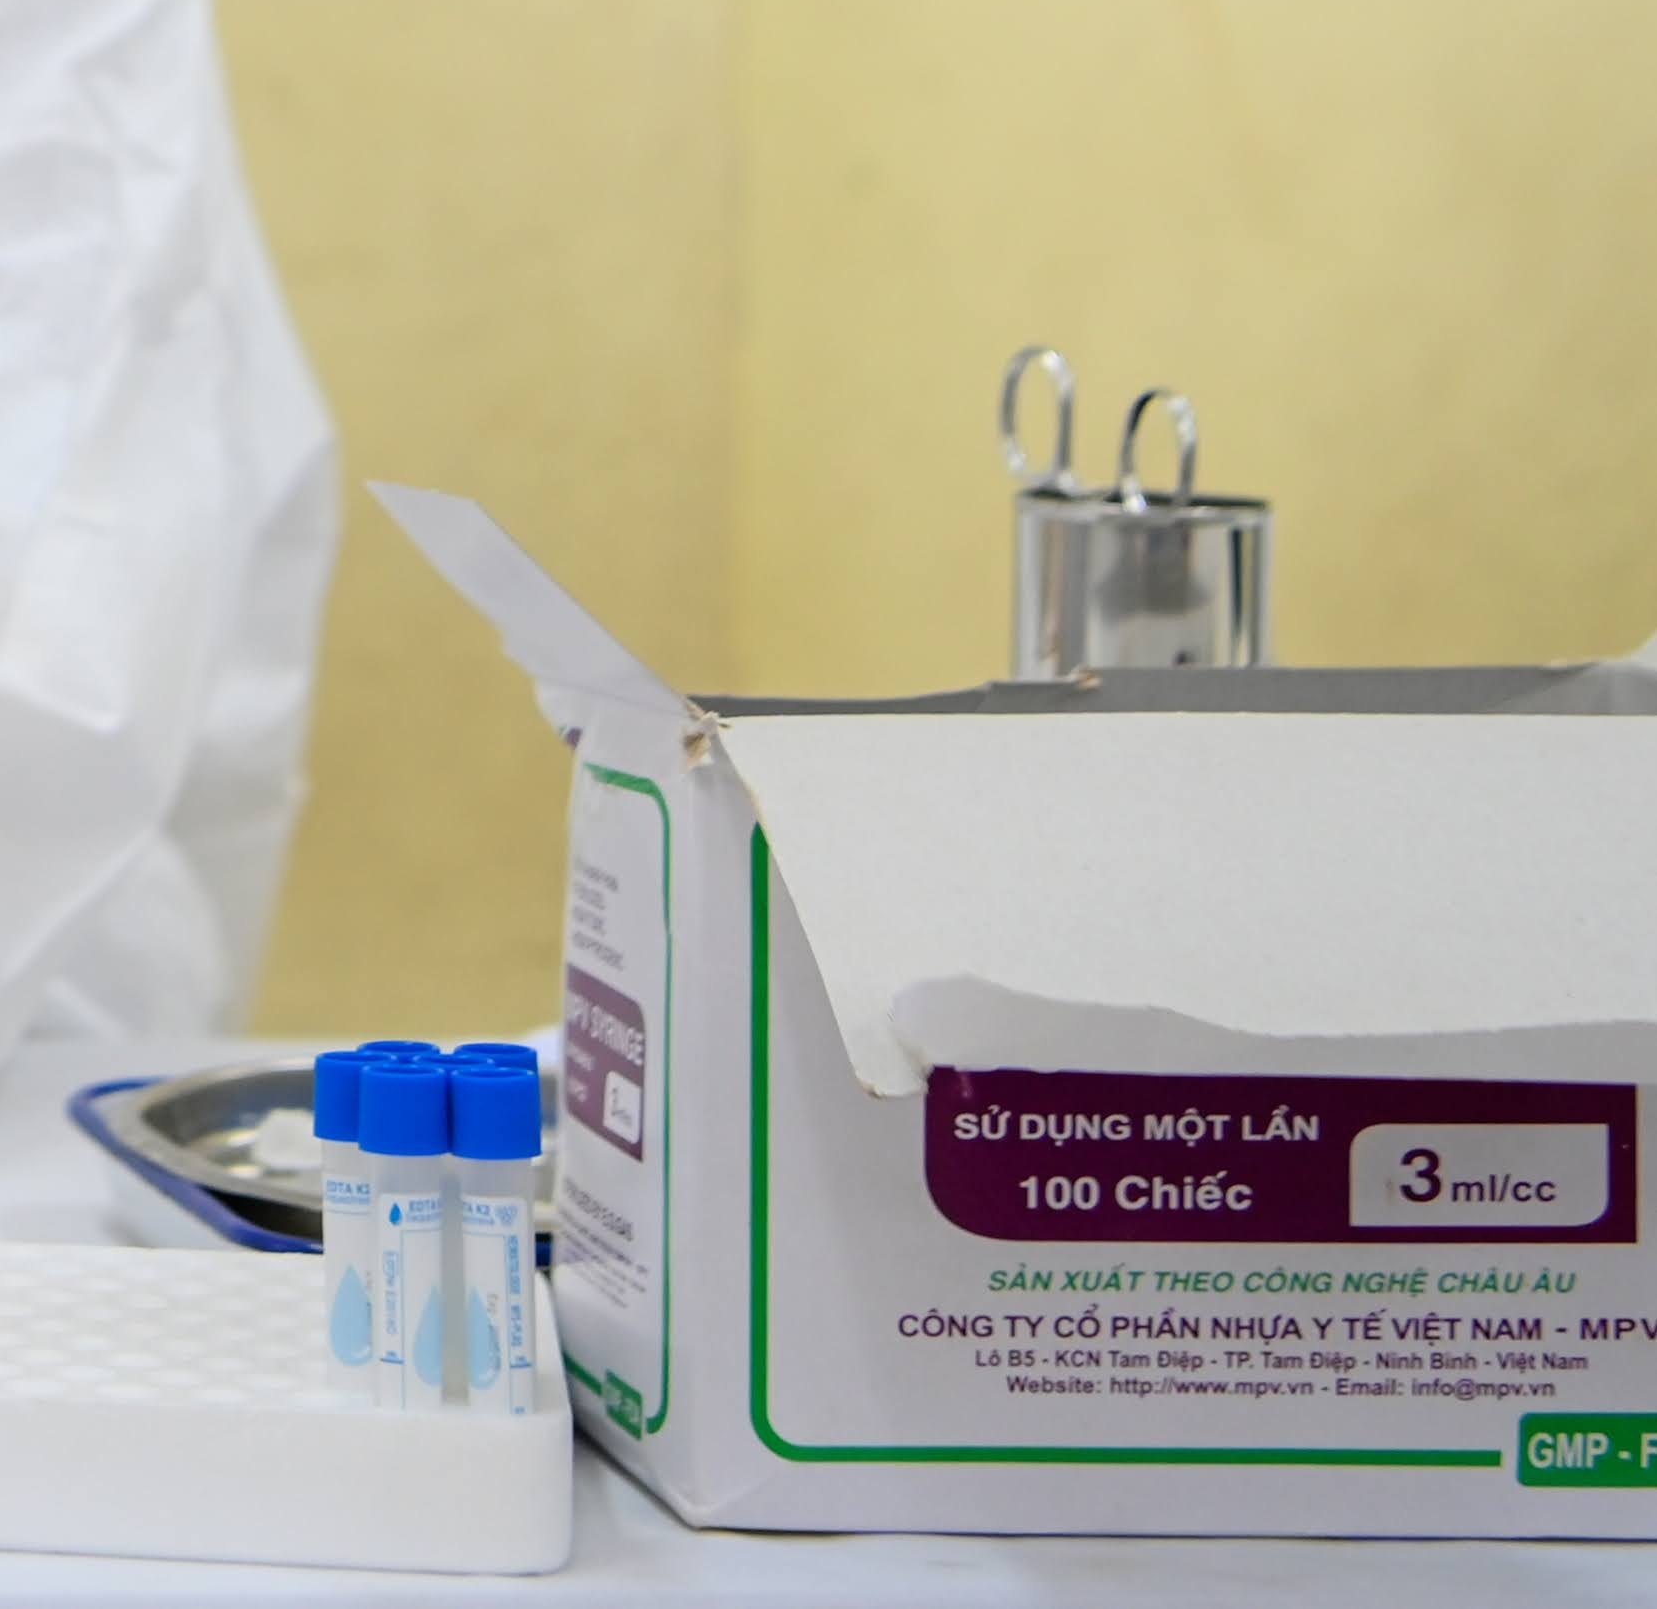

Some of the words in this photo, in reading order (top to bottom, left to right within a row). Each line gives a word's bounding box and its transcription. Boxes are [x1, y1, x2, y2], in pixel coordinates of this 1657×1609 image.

[953, 1104, 1012, 1141] SỬ
[1019, 1113, 1132, 1146] DỤNG
[1144, 1107, 1231, 1146] MỘT
[1019, 1175, 1100, 1210] 100
[1115, 1170, 1253, 1211] Chiếc
[1399, 1147, 1442, 1203] 3
[1451, 1174, 1556, 1203] ml/cc
[989, 1263, 1053, 1292] SẢN
[1060, 1262, 1145, 1293] XUẤT
[1154, 1270, 1235, 1293] THEO
[1242, 1267, 1333, 1294] CÔNG
[1342, 1267, 1429, 1297] NGHỆ
[1437, 1266, 1524, 1294] CHÂU
[898, 1308, 994, 1338] CÔNG
[1004, 1315, 1044, 1338] TY
[1053, 1303, 1101, 1339] CỔ
[1211, 1314, 1303, 1346] NHỰA
[1312, 1317, 1334, 1340] Y
[1342, 1308, 1387, 1341] TẾ
[1391, 1311, 1462, 1347] VIỆT
[1471, 1317, 1543, 1341] NAM
[1580, 1317, 1657, 1341] MPV
[975, 1349, 1002, 1367] Lô
[1008, 1349, 1036, 1367] B5
[1054, 1350, 1101, 1368] KCN
[1108, 1350, 1150, 1368] Tam
[1157, 1350, 1204, 1372] Điệp
[1262, 1351, 1303, 1370] Tam
[1309, 1351, 1357, 1374] Điệp
[1376, 1352, 1423, 1370] Ninh
[1497, 1352, 1536, 1374] Việt
[1542, 1352, 1588, 1370] Nam
[1006, 1376, 1102, 1394] Website:
[1335, 1377, 1404, 1396] Email:
[1411, 1378, 1556, 1401] info@mpv.vn
[1527, 1432, 1609, 1469] GMP
